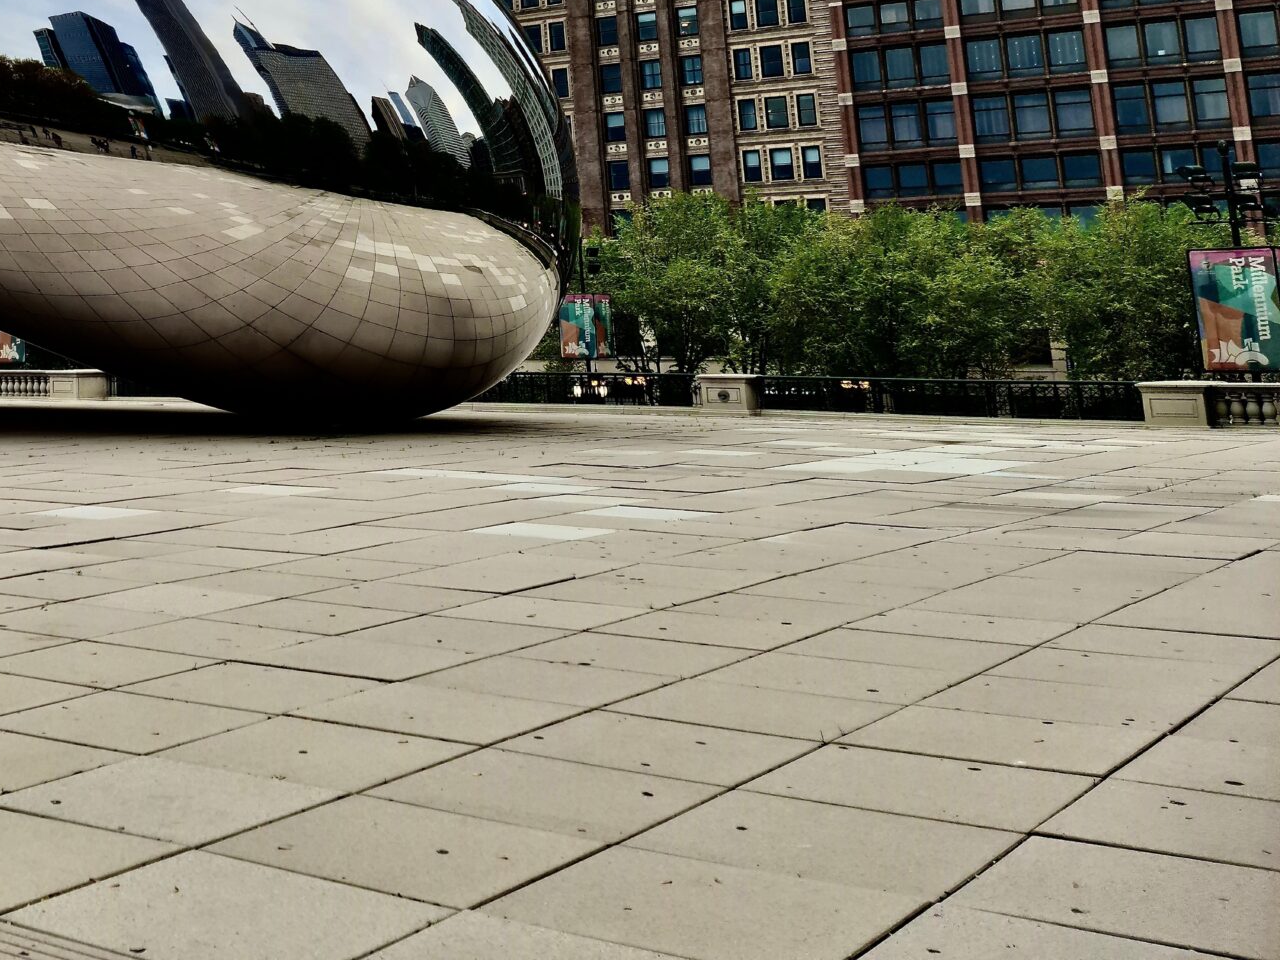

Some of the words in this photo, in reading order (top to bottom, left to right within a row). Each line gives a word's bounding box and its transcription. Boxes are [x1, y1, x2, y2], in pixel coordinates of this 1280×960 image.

[1229, 257, 1249, 290] Park
[574, 298, 583, 316] Park
[1248, 256, 1272, 341] Millennium
